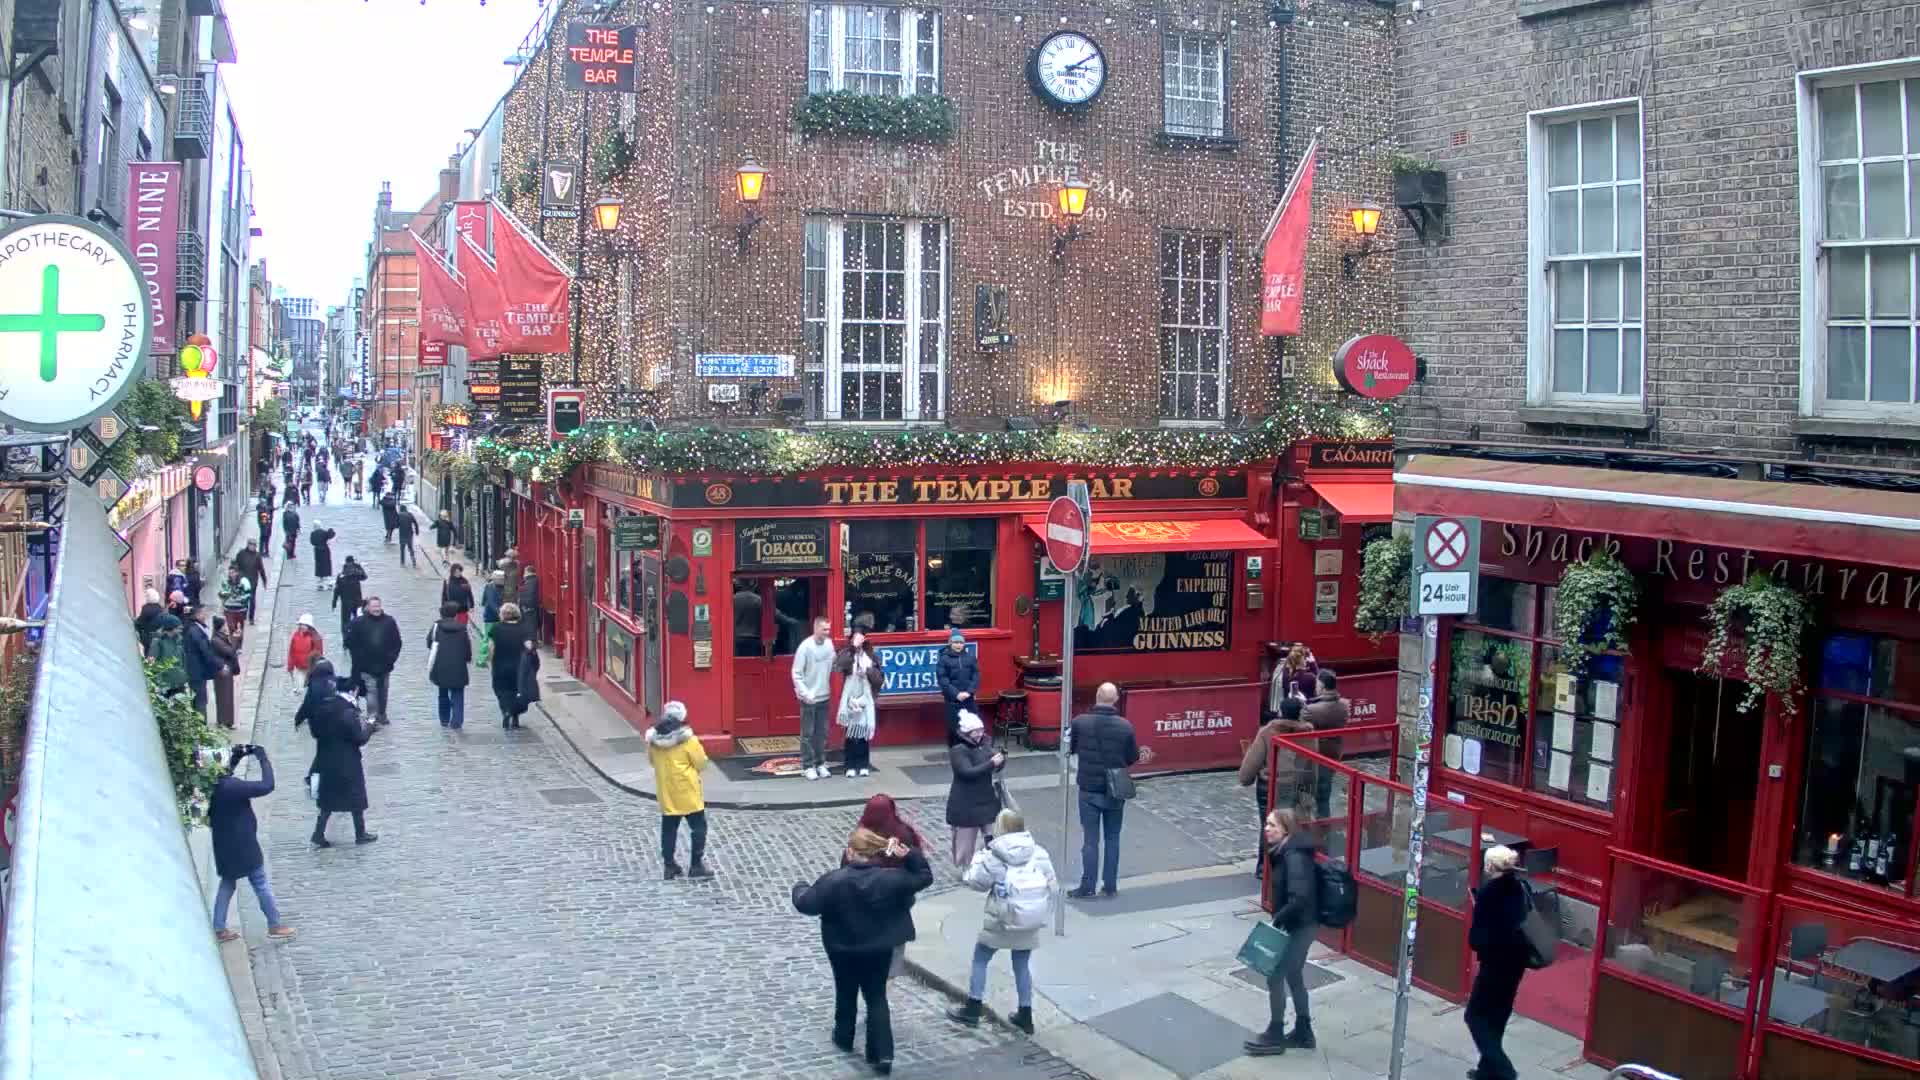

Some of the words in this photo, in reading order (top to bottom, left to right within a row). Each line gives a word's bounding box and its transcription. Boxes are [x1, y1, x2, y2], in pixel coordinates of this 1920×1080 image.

[586, 29, 618, 45] THE
[569, 47, 634, 63] TEMPLE
[585, 69, 617, 83] BAR
[1036, 139, 1083, 162] THE
[977, 163, 1080, 202] TEMPLE
[137, 171, 170, 232] NINE
[543, 209, 577, 218] GUINNESS
[1265, 284, 1297, 298] EMPLE
[524, 303, 549, 312] THE
[504, 312, 565, 324] TEMPLE
[475, 327, 500, 338] TEM
[521, 324, 553, 336] BAR
[89, 302, 137, 401] PHARMACY
[510, 362, 531, 370] BAR
[730, 366, 752, 374] LANE
[754, 366, 779, 374] SOUTH
[711, 485, 727, 500] 48
[824, 481, 899, 503] THE
[913, 479, 1051, 502] TEMPLE
[1068, 478, 1135, 498] AR
[751, 538, 817, 561] TOBACCO
[1204, 562, 1227, 577] THE
[1176, 578, 1227, 593] EMPEROR
[1212, 592, 1225, 607] OF
[1423, 584, 1443, 603] 24
[1444, 593, 1467, 602] HOUR
[1139, 615, 1182, 632] MALTED
[1184, 608, 1226, 628] LIQUORS
[1133, 631, 1225, 650] GUINNESS
[881, 649, 939, 668] POWE
[880, 671, 938, 689] WHIS
[1184, 710, 1205, 719] THE
[1354, 703, 1377, 715] BAR
[1155, 718, 1204, 732] TEMPLE
[1207, 716, 1233, 728] BAR
